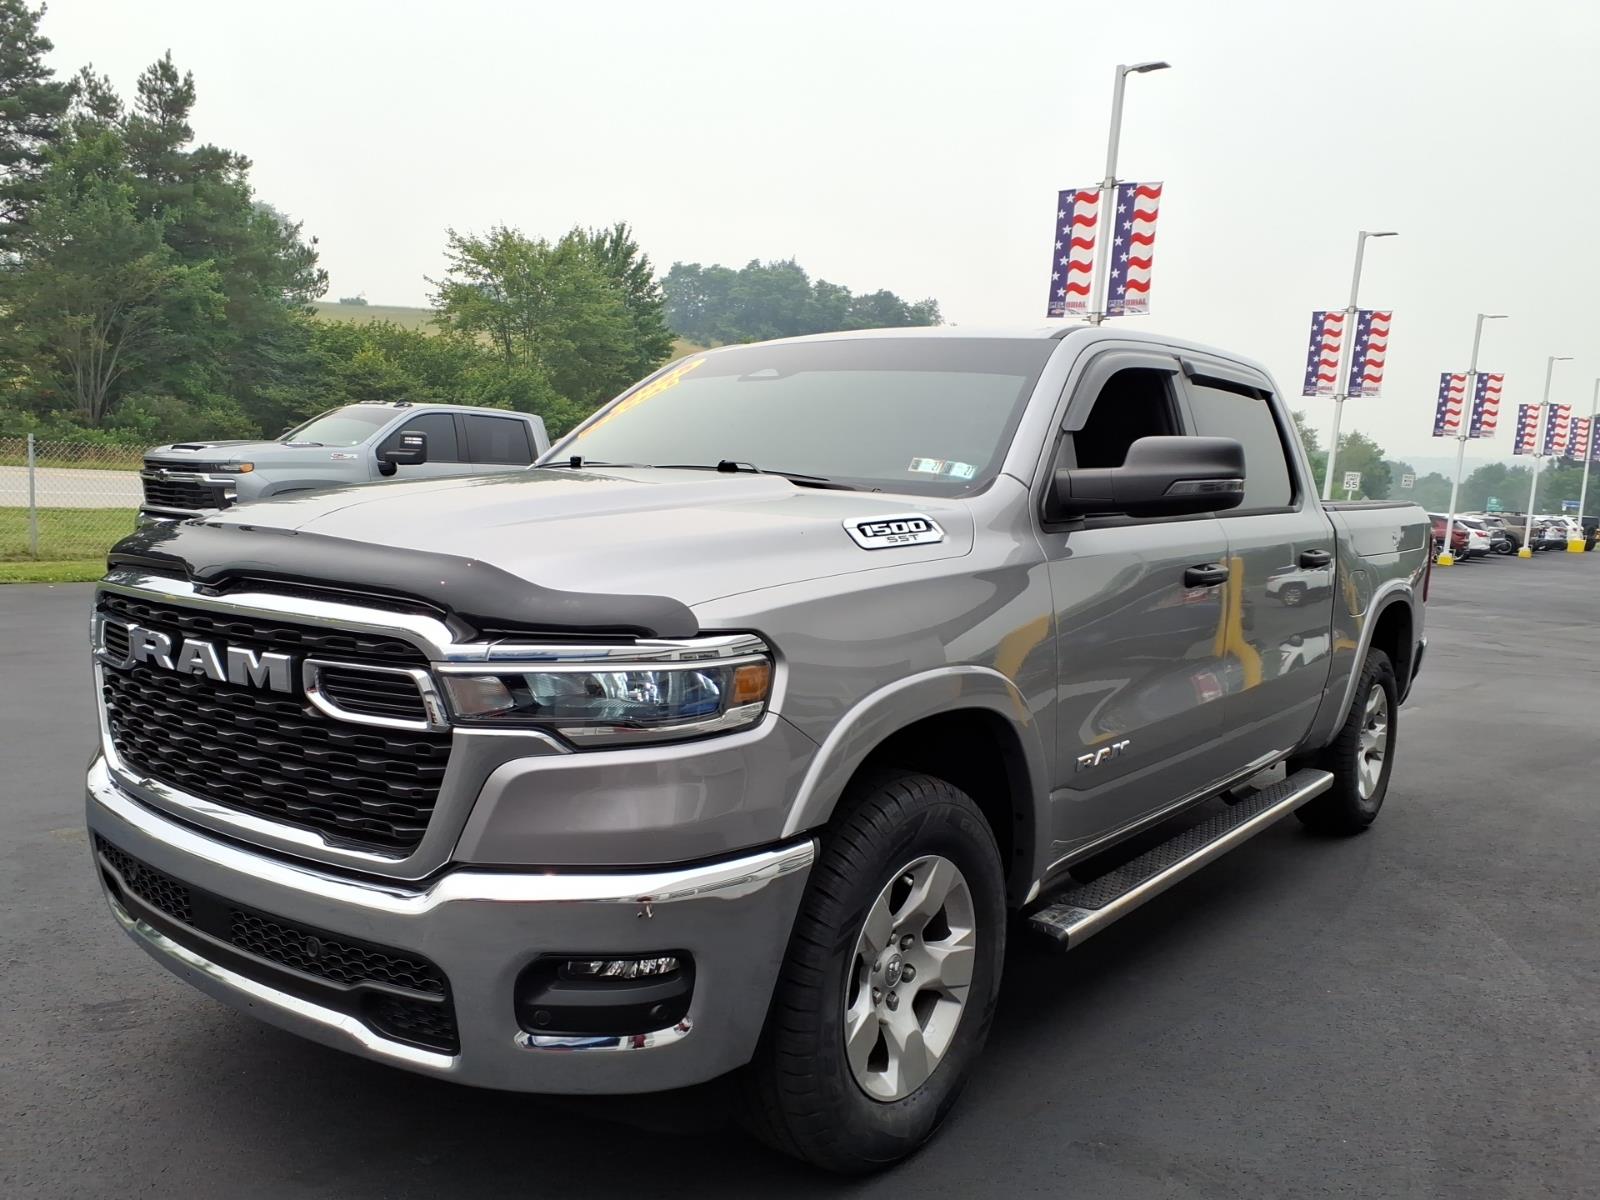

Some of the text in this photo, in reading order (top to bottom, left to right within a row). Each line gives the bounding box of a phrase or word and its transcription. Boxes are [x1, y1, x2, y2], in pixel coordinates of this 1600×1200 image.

[1345, 481, 1358, 489] 55
[860, 520, 928, 537] 1500
[886, 533, 919, 543] SST
[133, 625, 292, 694] RAM
